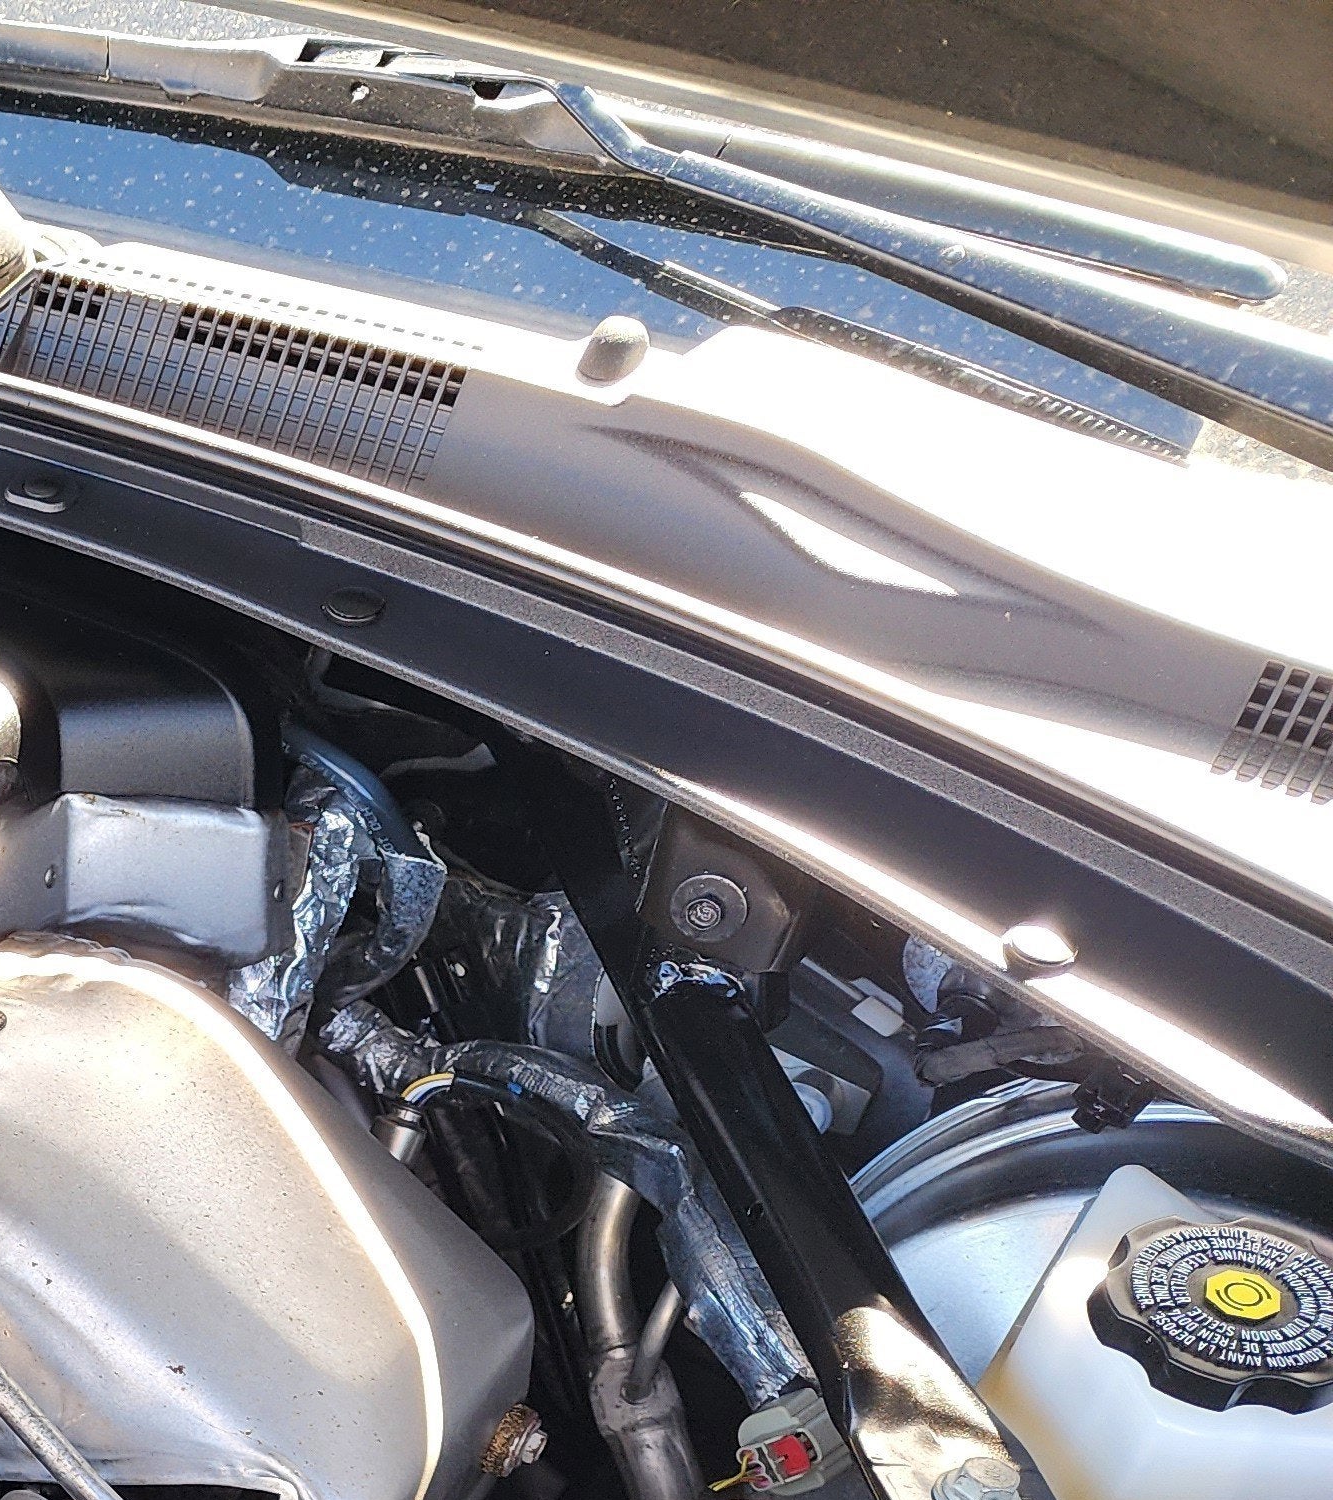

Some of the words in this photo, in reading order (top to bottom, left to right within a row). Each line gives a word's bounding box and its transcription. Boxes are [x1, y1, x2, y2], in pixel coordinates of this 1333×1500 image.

[1184, 1226, 1220, 1240] FROM
[1219, 1226, 1260, 1241] FLUID
[1138, 1236, 1178, 1262] SEALED
[1210, 1236, 1261, 1254] BEFORE
[1173, 1252, 1211, 1277] CLEAN
[1262, 1246, 1289, 1264] CAP
[1150, 1266, 1169, 1285] USE
[1151, 1283, 1176, 1307] ONLY
[1170, 1273, 1193, 1306] FILLER
[1275, 1268, 1317, 1321] PROVENANT
[1186, 1305, 1236, 1337] SCELLE
[1196, 1327, 1238, 1350] FREIN
[1241, 1329, 1284, 1343] BIDON
[1304, 1328, 1328, 1343] DU
[1197, 1340, 1217, 1356] LA
[1243, 1341, 1260, 1354] DE
[1262, 1336, 1313, 1355] LIQUIDE
[1217, 1348, 1263, 1367] AVANT
[1265, 1346, 1328, 1368] BOUCHON
